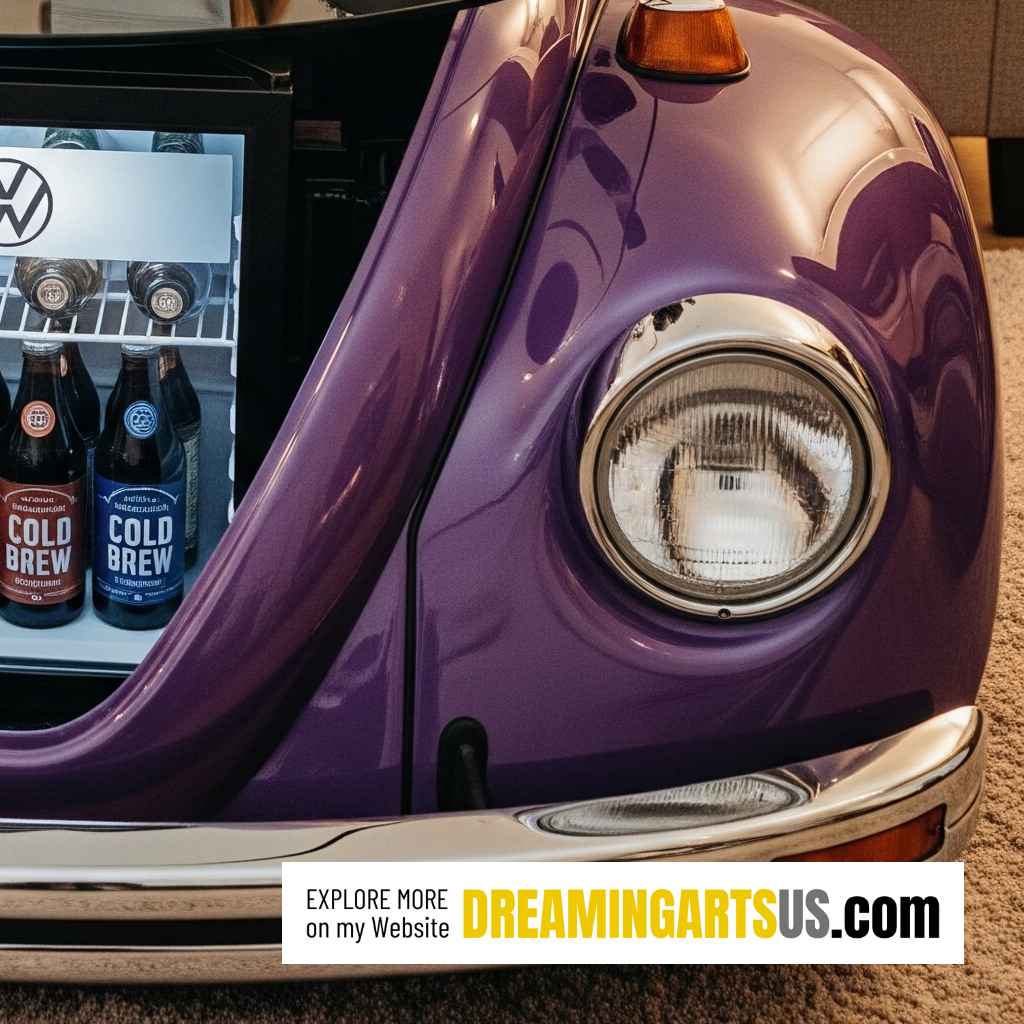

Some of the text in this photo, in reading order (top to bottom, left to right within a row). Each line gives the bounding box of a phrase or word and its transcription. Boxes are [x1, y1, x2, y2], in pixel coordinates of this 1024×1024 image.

[8, 513, 72, 547] COLD
[108, 514, 173, 547] COLD
[5, 543, 72, 576] BREW
[107, 543, 174, 577] BREW
